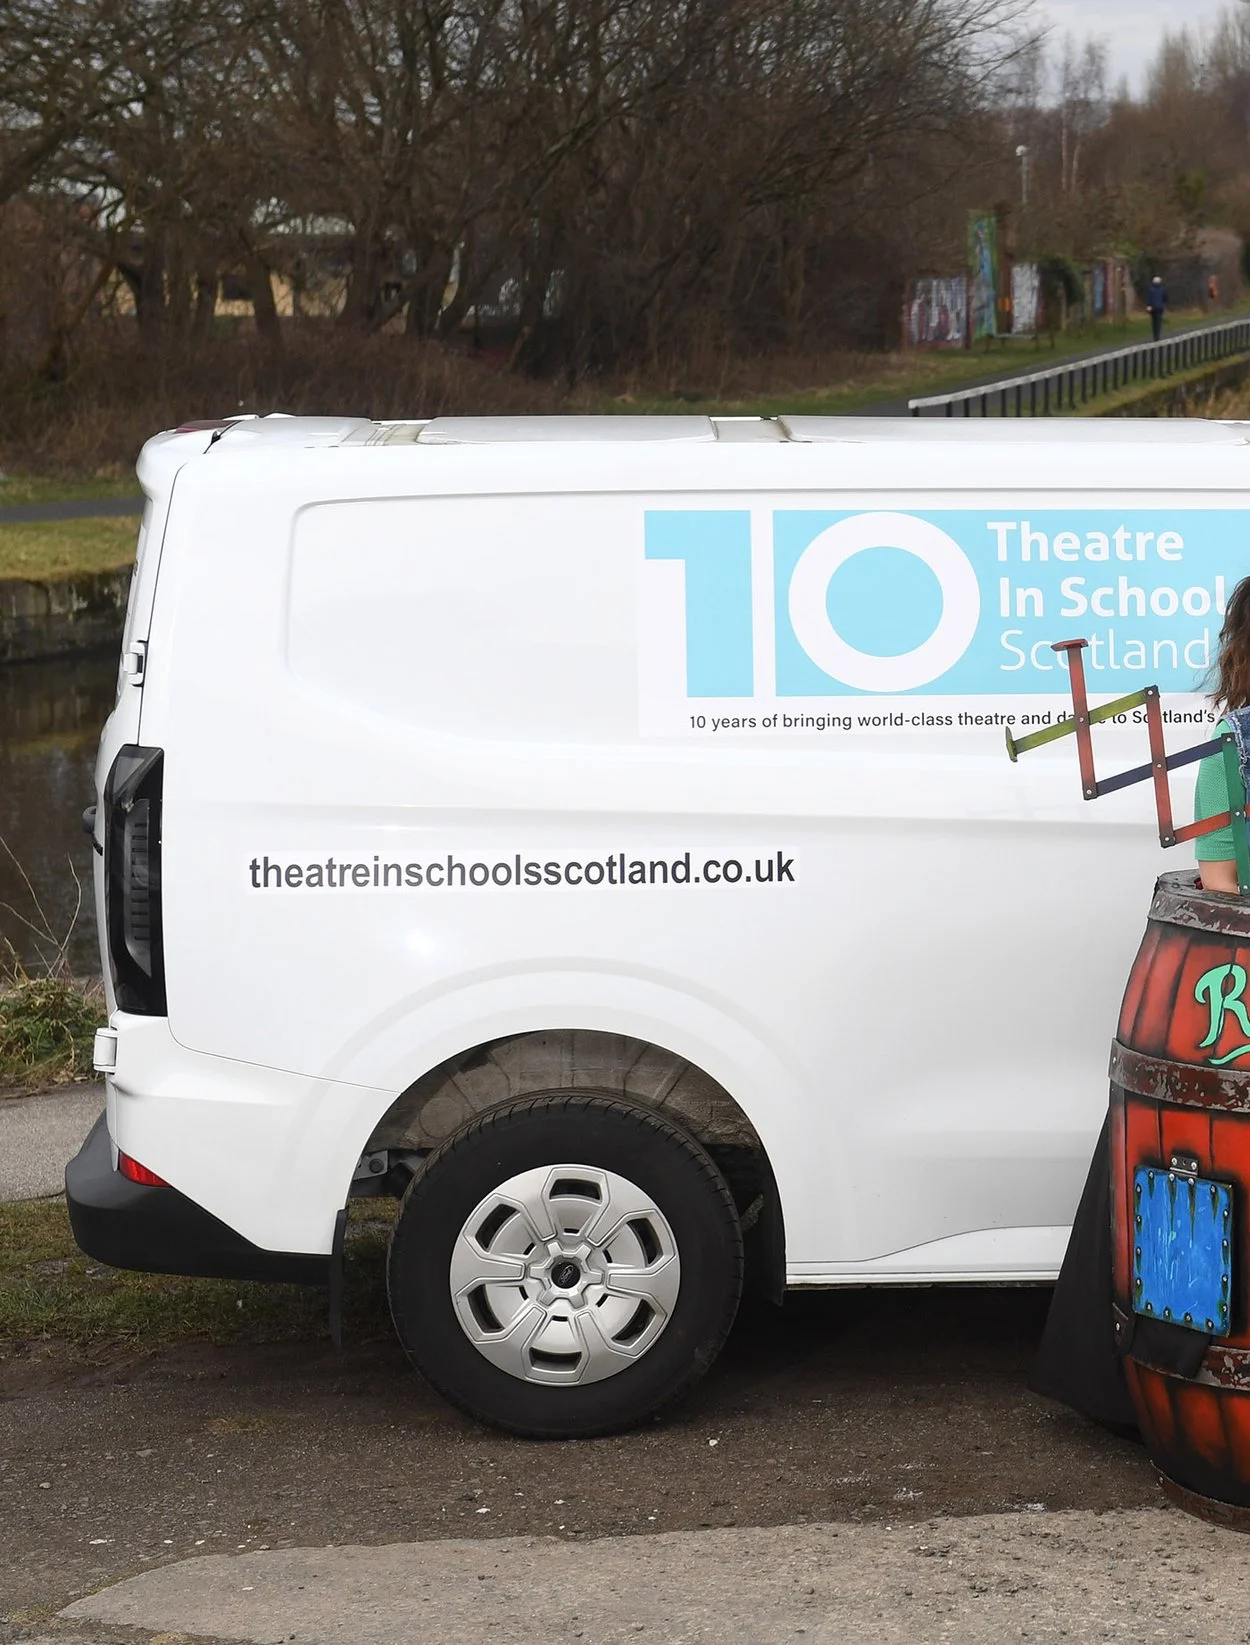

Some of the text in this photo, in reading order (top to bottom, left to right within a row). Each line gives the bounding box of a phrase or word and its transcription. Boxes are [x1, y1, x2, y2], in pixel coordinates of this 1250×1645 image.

[987, 521, 1184, 561] Theatre
[644, 510, 981, 697] 10
[1000, 576, 1227, 617] In School
[690, 715, 706, 729] 10
[711, 717, 757, 732] years
[762, 713, 778, 728] of
[783, 713, 852, 731] bringing
[857, 712, 953, 727] world-class
[957, 711, 1016, 726] theatre
[1021, 711, 1051, 725] and
[1112, 713, 1127, 724] to
[1132, 709, 1216, 724] Sctland's
[249, 850, 796, 889] theatreinschoolsscotland.co.uk
